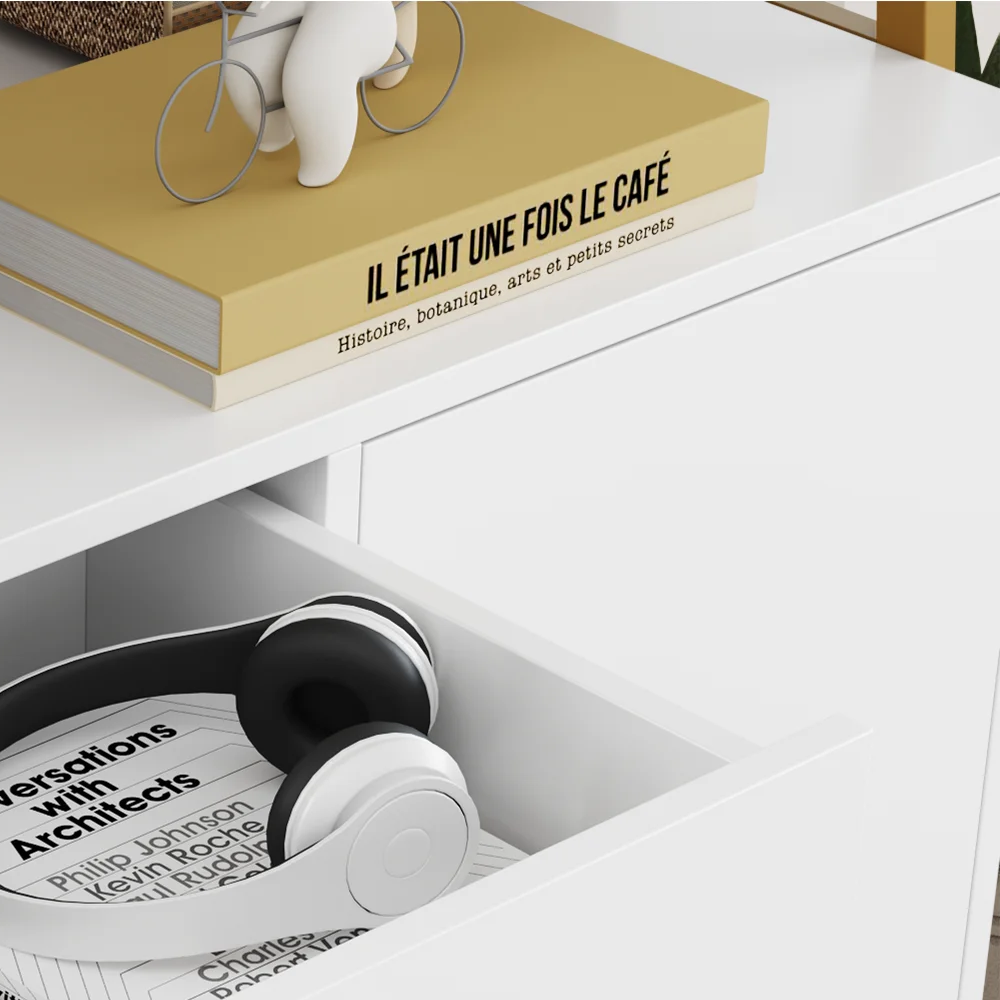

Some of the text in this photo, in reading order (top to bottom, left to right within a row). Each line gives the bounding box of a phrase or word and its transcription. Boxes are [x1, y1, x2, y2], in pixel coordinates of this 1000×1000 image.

[367, 150, 671, 304] IL ÉTAIT UNE FOIS LE CAFÉ
[337, 216, 675, 354] Histoire, botanique, arts et petits secrets
[10, 774, 201, 861] Architects
[30, 780, 119, 817] with
[46, 800, 255, 892] Philip Johnson
[84, 862, 172, 902] Kevin
[165, 820, 265, 865] Roche
